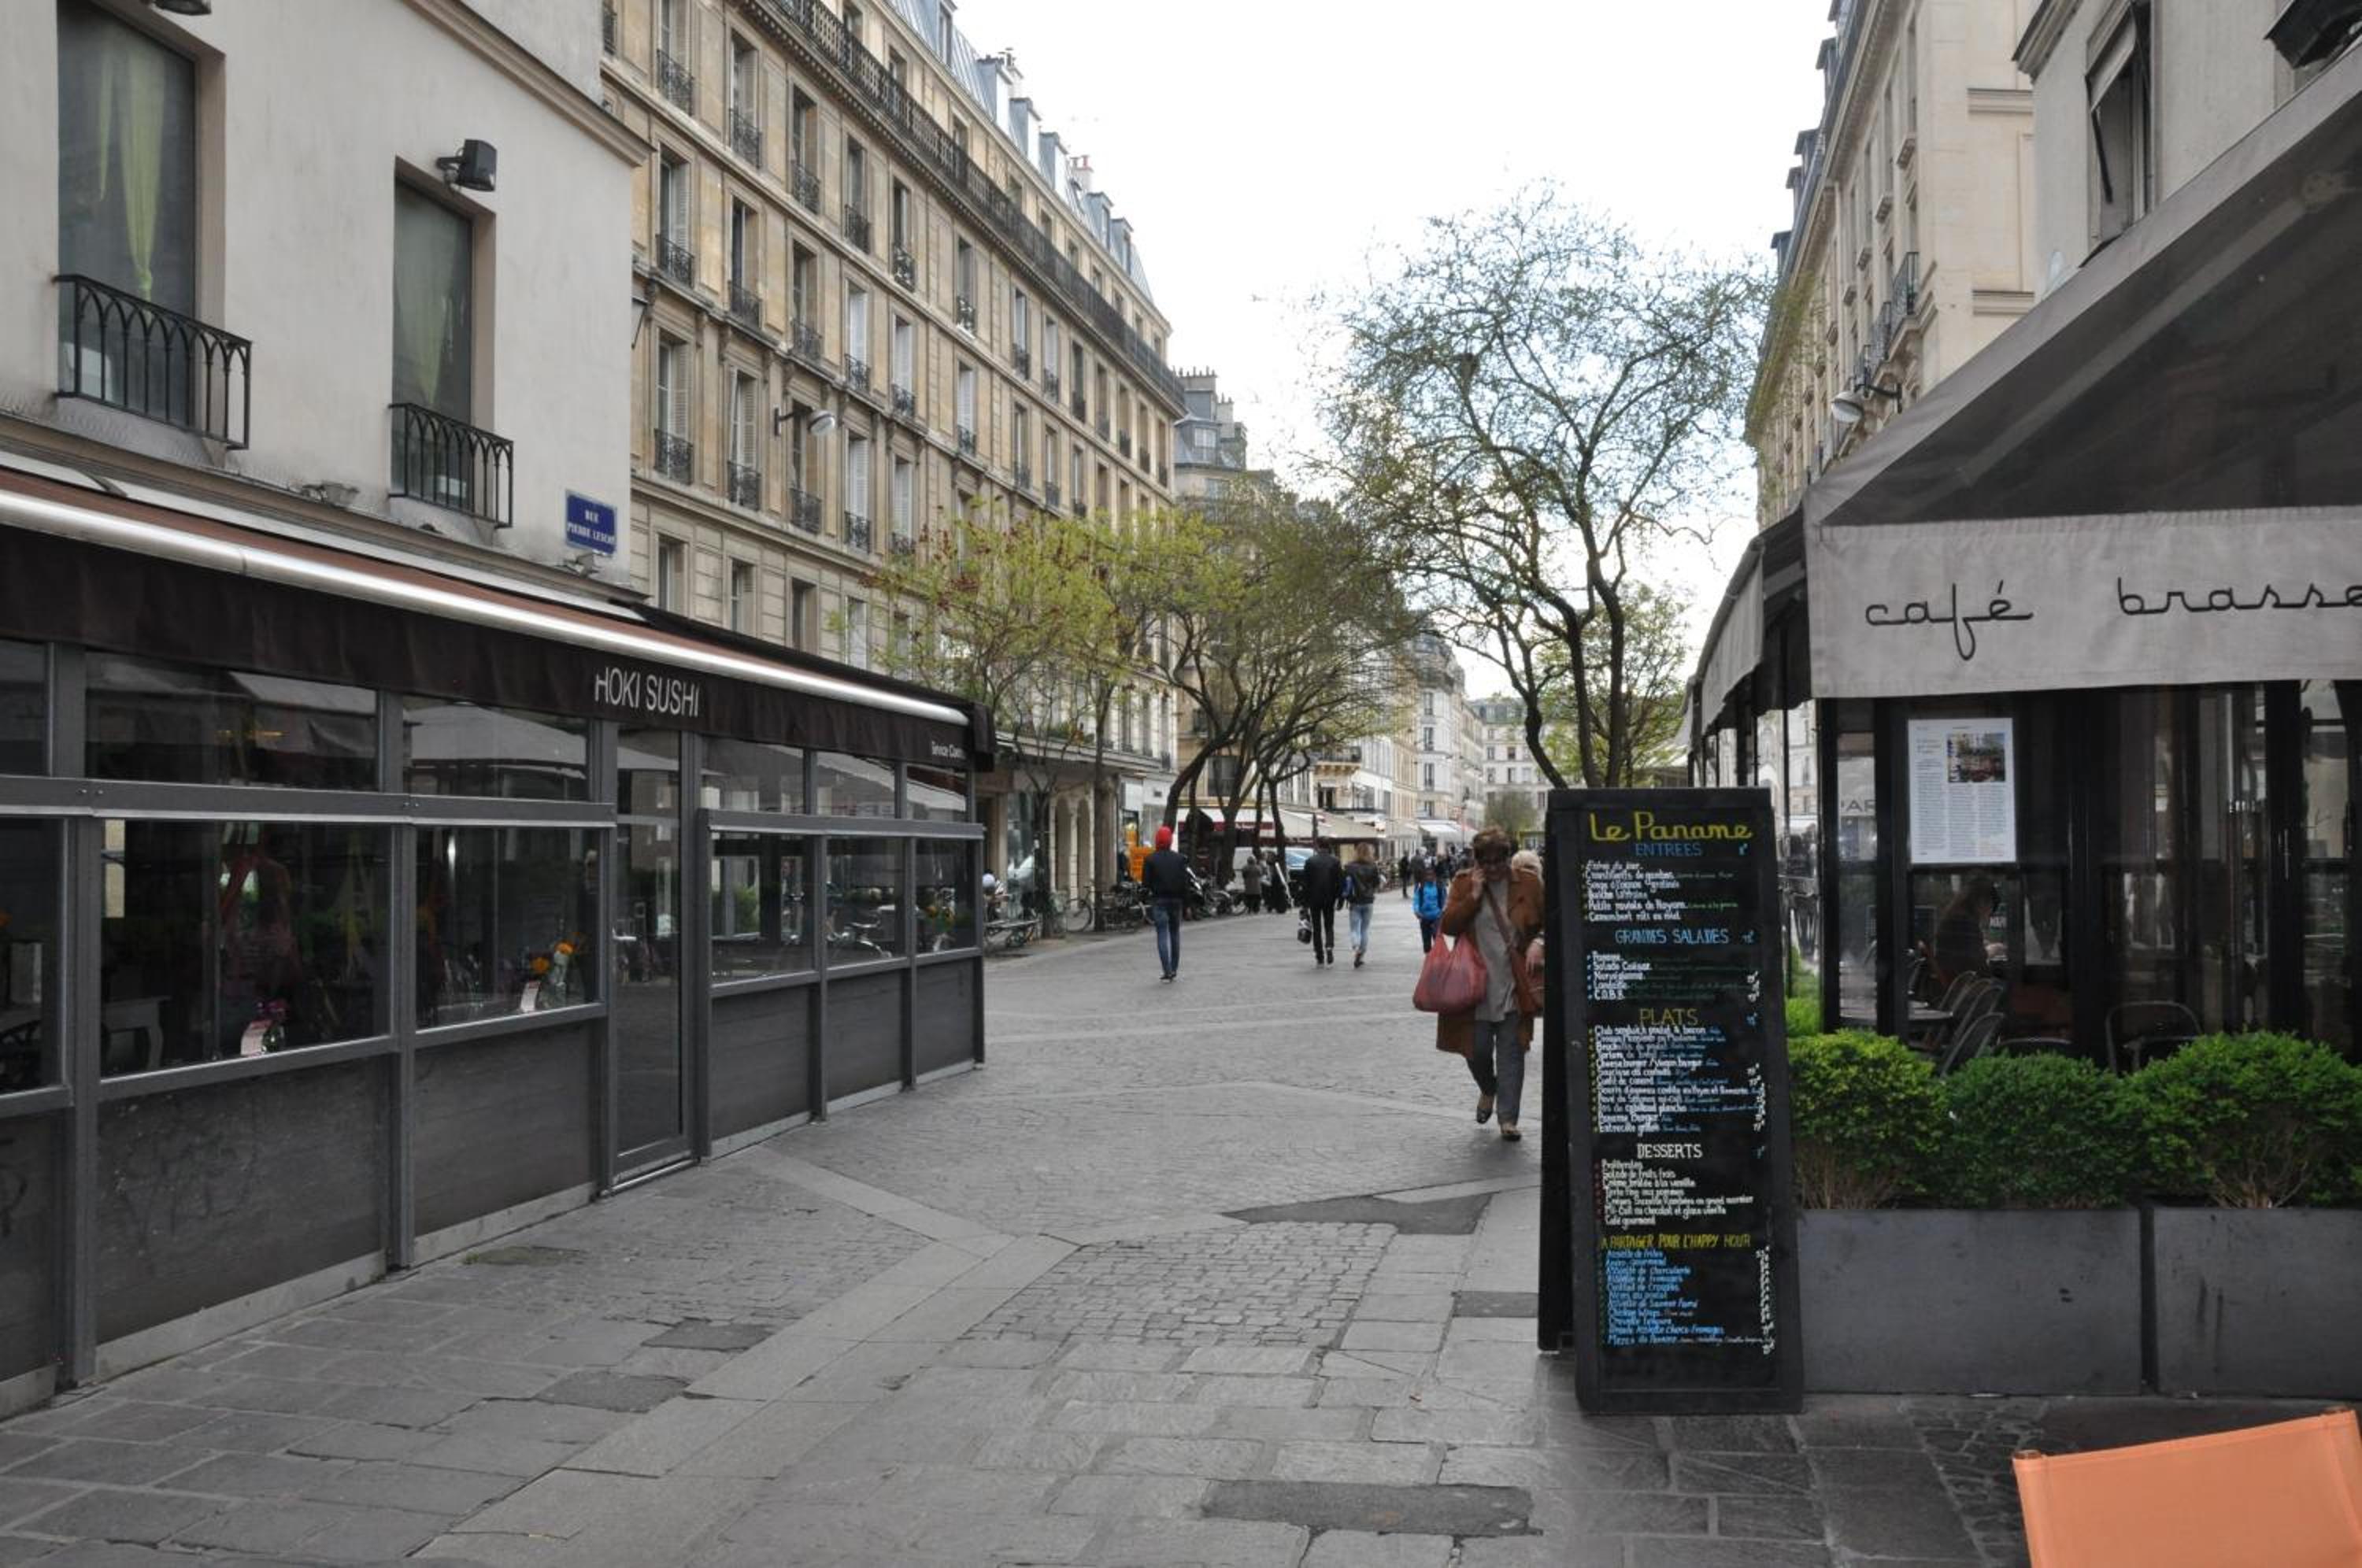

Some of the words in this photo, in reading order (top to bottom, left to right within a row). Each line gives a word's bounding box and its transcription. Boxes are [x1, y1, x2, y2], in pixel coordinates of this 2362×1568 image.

[1865, 580, 2034, 661] café
[594, 667, 641, 709] HOKI
[646, 674, 700, 718] SUSHI
[1590, 812, 1631, 841] Le
[1634, 811, 1753, 841] Paname
[1635, 843, 1702, 856] ENTREES
[1672, 929, 1729, 943] SALADES
[1639, 1008, 1699, 1025] PLATS
[1637, 1144, 1702, 1159] DESSERTS
[1658, 1234, 1681, 1248] POUR
[1723, 1234, 1751, 1247] HOUR
